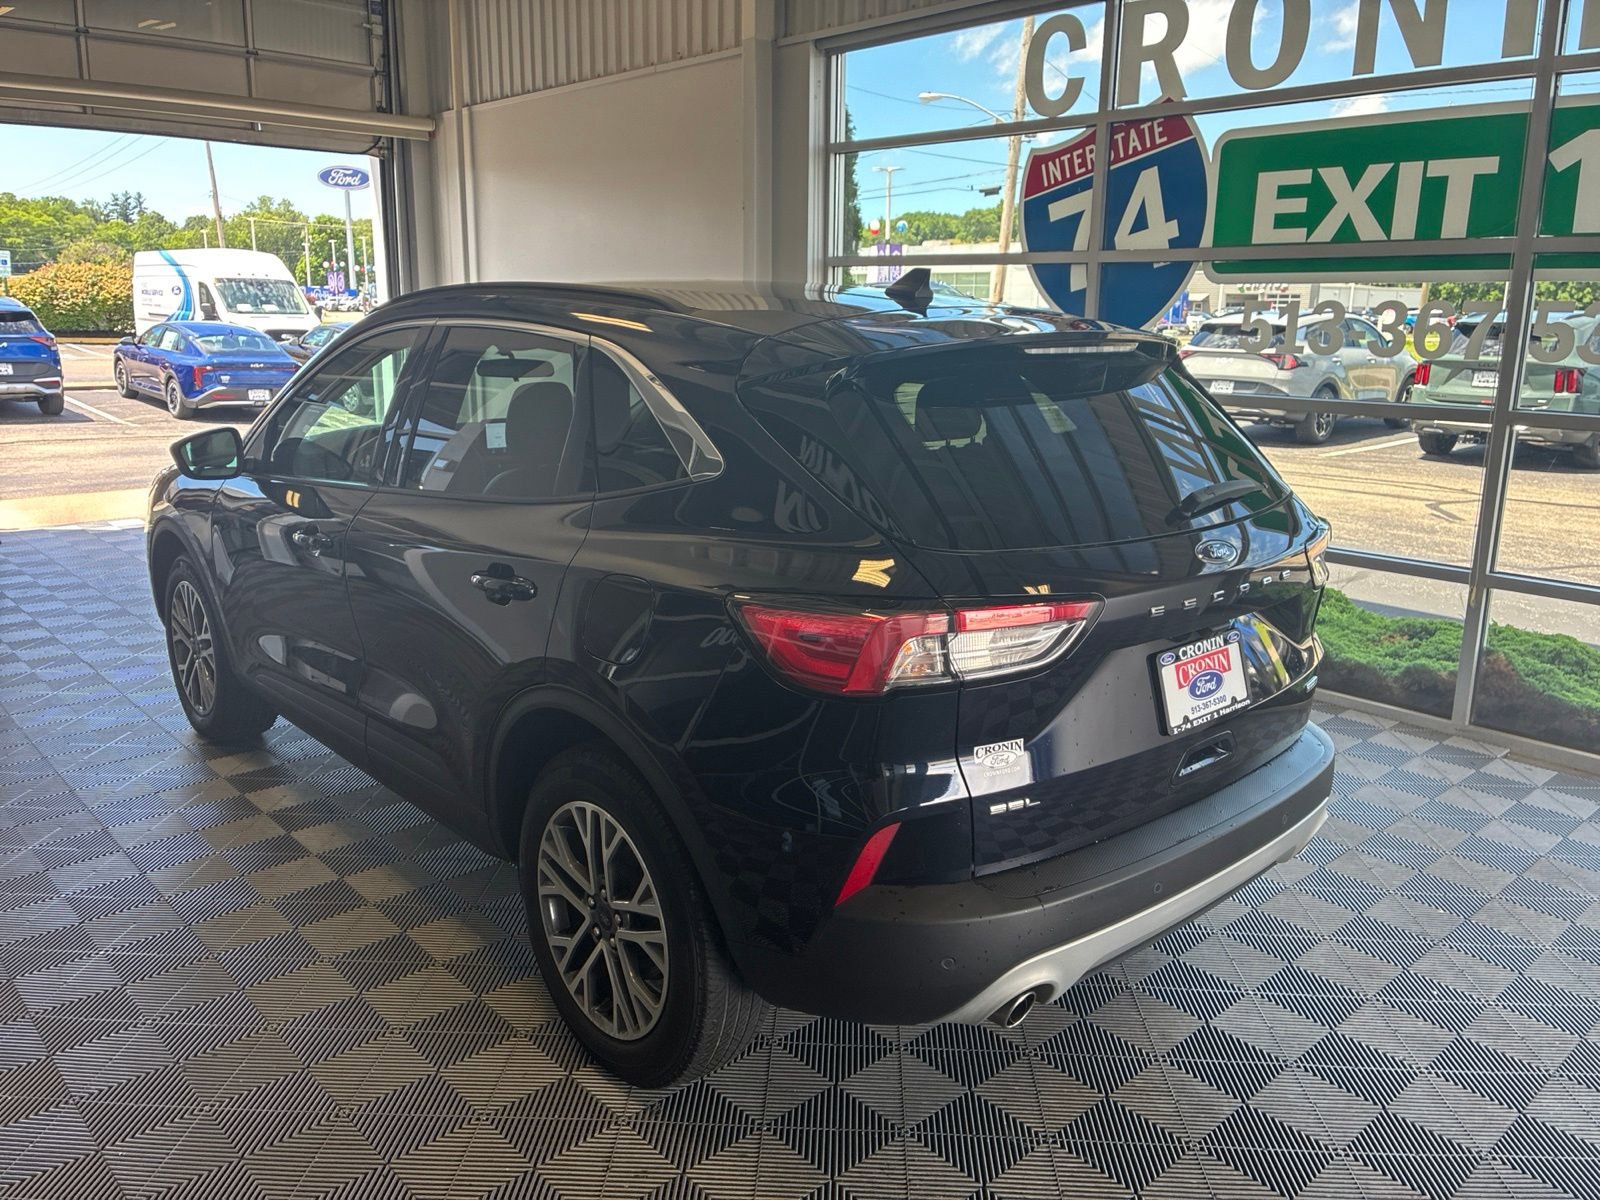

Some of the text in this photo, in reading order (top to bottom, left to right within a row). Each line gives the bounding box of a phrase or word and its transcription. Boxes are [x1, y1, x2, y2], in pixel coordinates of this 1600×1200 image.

[1025, 0, 1600, 118] CRON
[1041, 118, 1167, 187] INTERTATE
[328, 168, 362, 186] Ford
[1251, 156, 1500, 246] EXIT
[1048, 166, 1180, 292] 74
[1240, 300, 1600, 364] 513-3675
[1151, 569, 1291, 617] ESCAPE
[1179, 635, 1225, 660] CRONIN
[1179, 650, 1230, 686] CRONIN
[1195, 674, 1217, 695] Ford
[1173, 722, 1192, 735] I-74
[1193, 714, 1212, 724] EXIT
[1220, 699, 1251, 715] Harrison
[1191, 694, 1227, 715] 513-367-5300
[975, 740, 1022, 759] CRONIN
[990, 753, 1010, 766] Ford
[990, 797, 1041, 815] SEL
